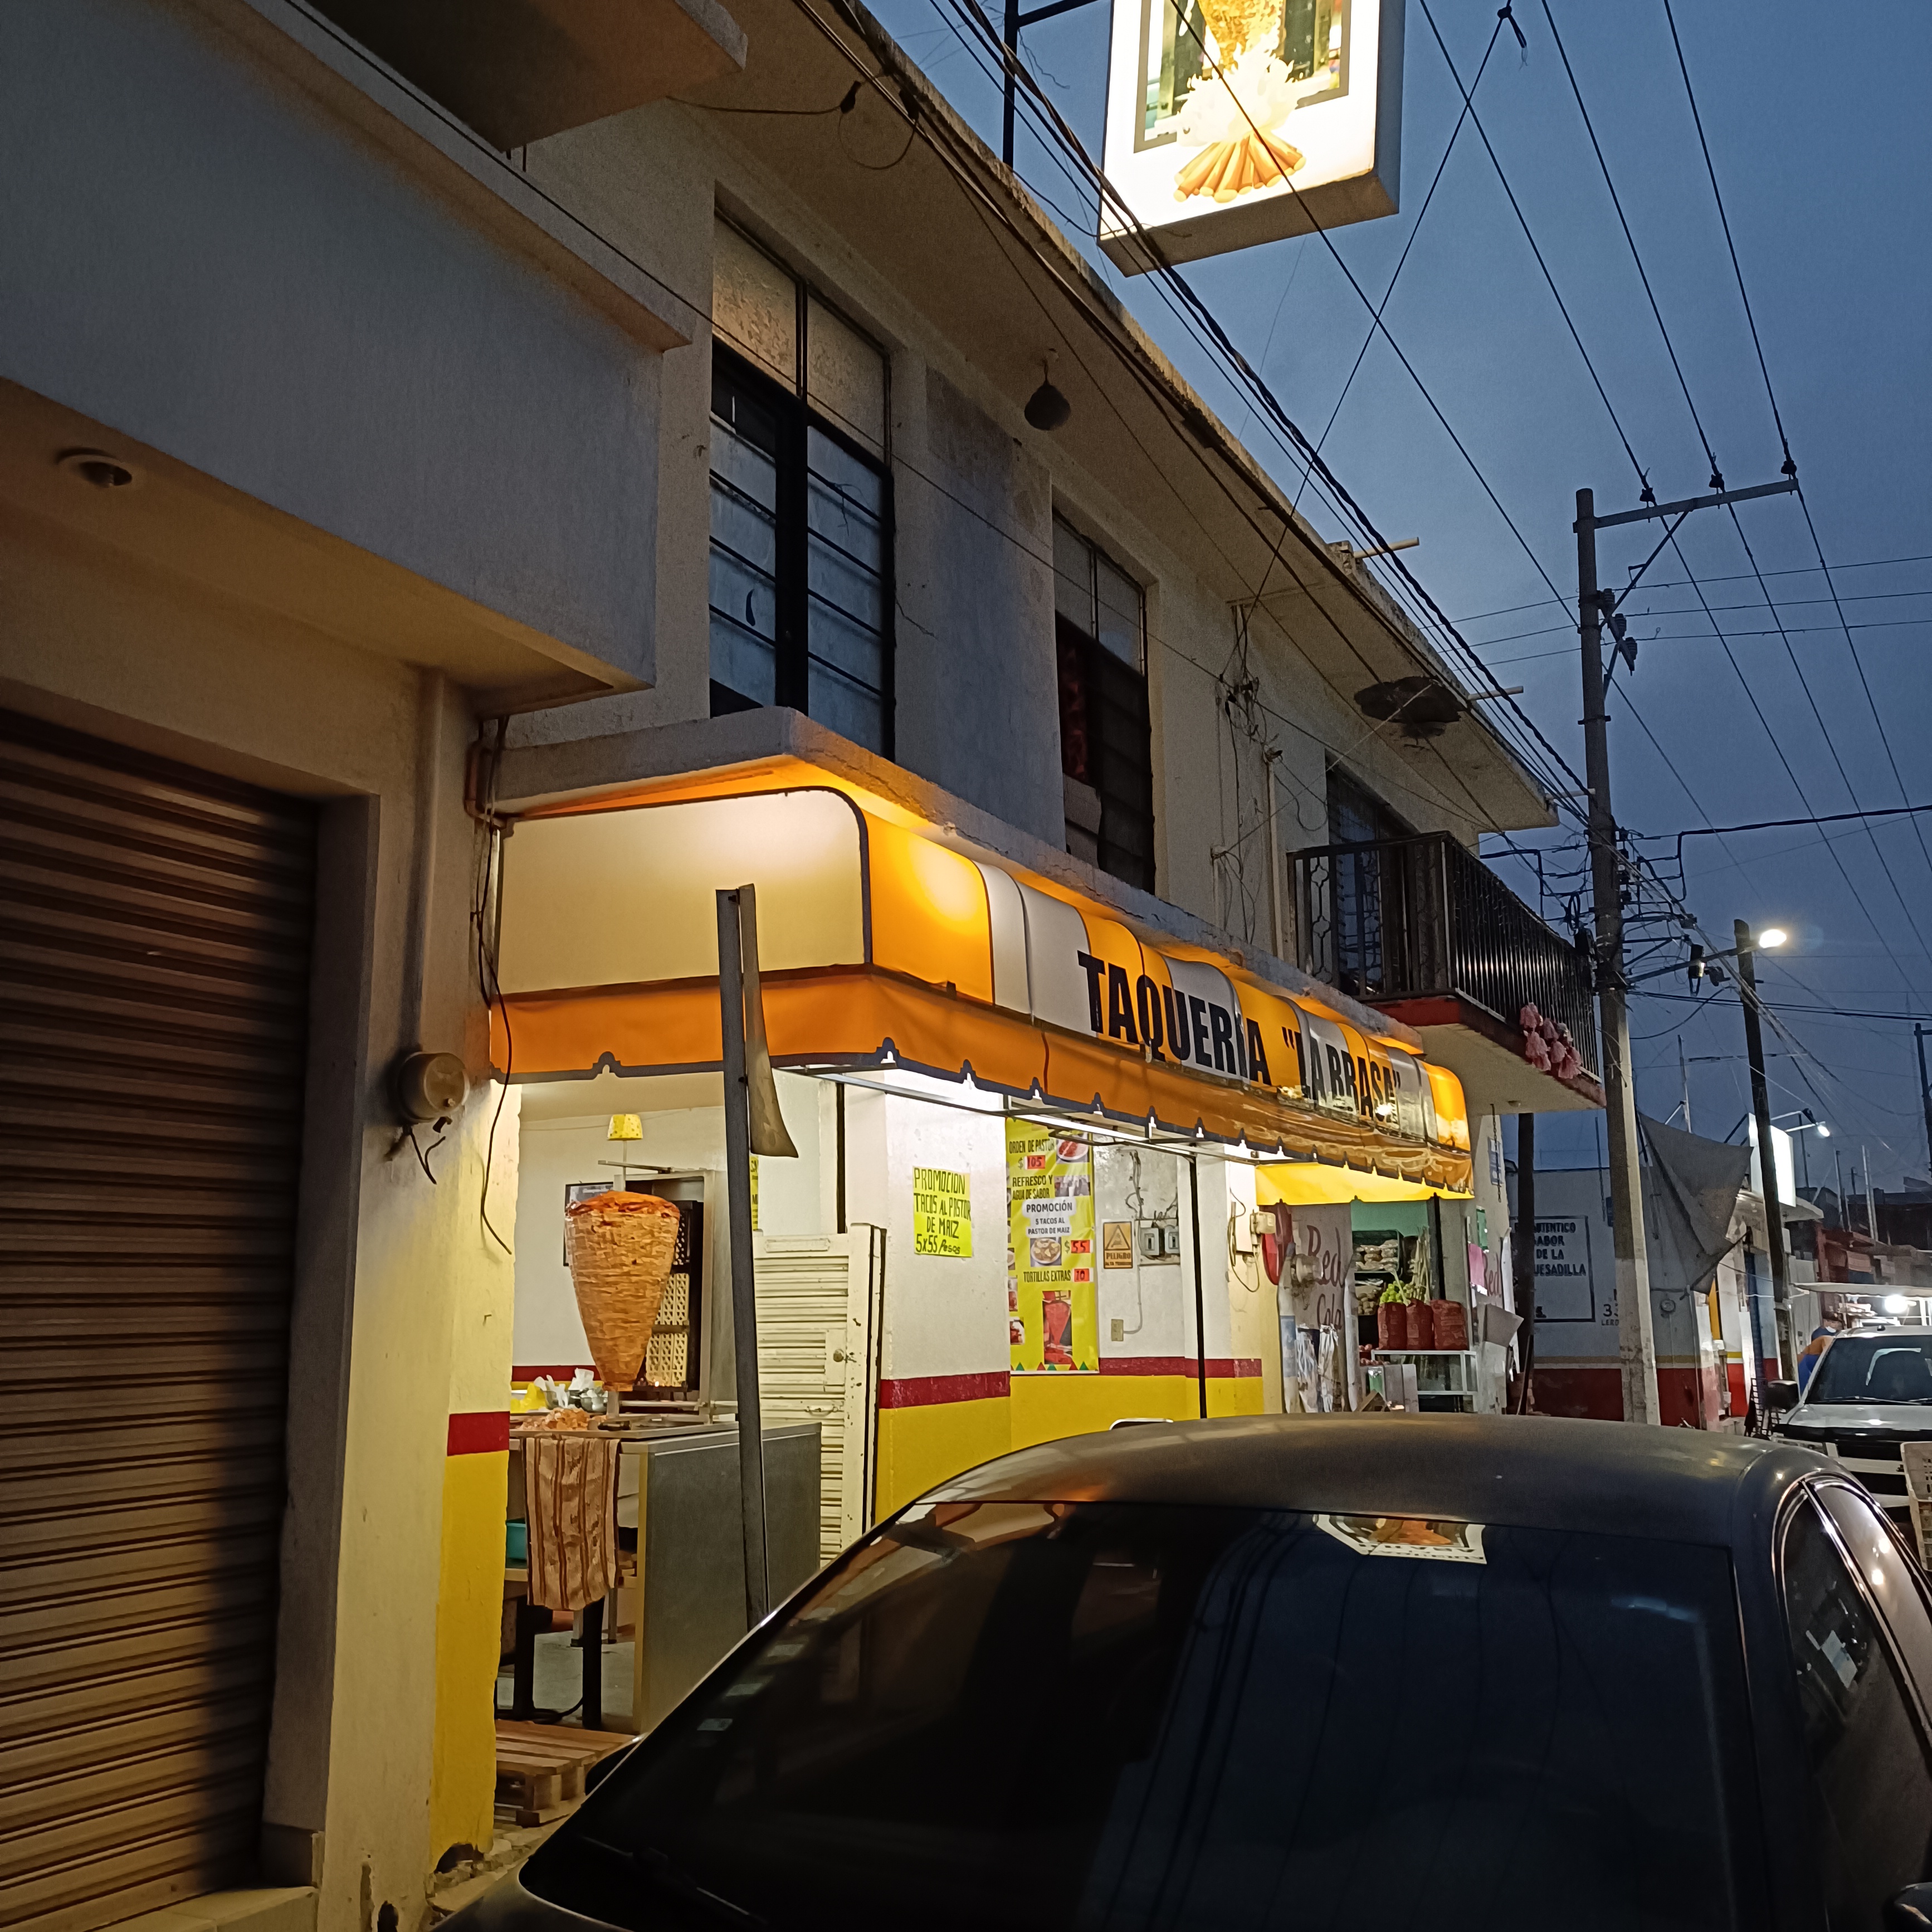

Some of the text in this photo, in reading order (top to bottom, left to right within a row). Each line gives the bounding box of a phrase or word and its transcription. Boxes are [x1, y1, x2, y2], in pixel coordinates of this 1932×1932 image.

[1009, 1138, 1055, 1154] ORDEN DE PASTOR
[1027, 1157, 1042, 1168] 105
[914, 1167, 965, 1194] PROMOCION
[1012, 1174, 1053, 1187] REFRESCO Y
[1012, 1188, 1050, 1201] AGUA DE SABOR
[914, 1193, 971, 1221] TACOS AL PASTOR
[1026, 1199, 1072, 1213] PROMOCIÓN
[926, 1216, 959, 1238] DE MAIZ
[1534, 1236, 1565, 1246] ABOR
[1536, 1249, 1564, 1260] DE LA
[1023, 1270, 1085, 1282] TORTILLAS EXTRAS 10
[1534, 1263, 1587, 1276] UESADILLA
